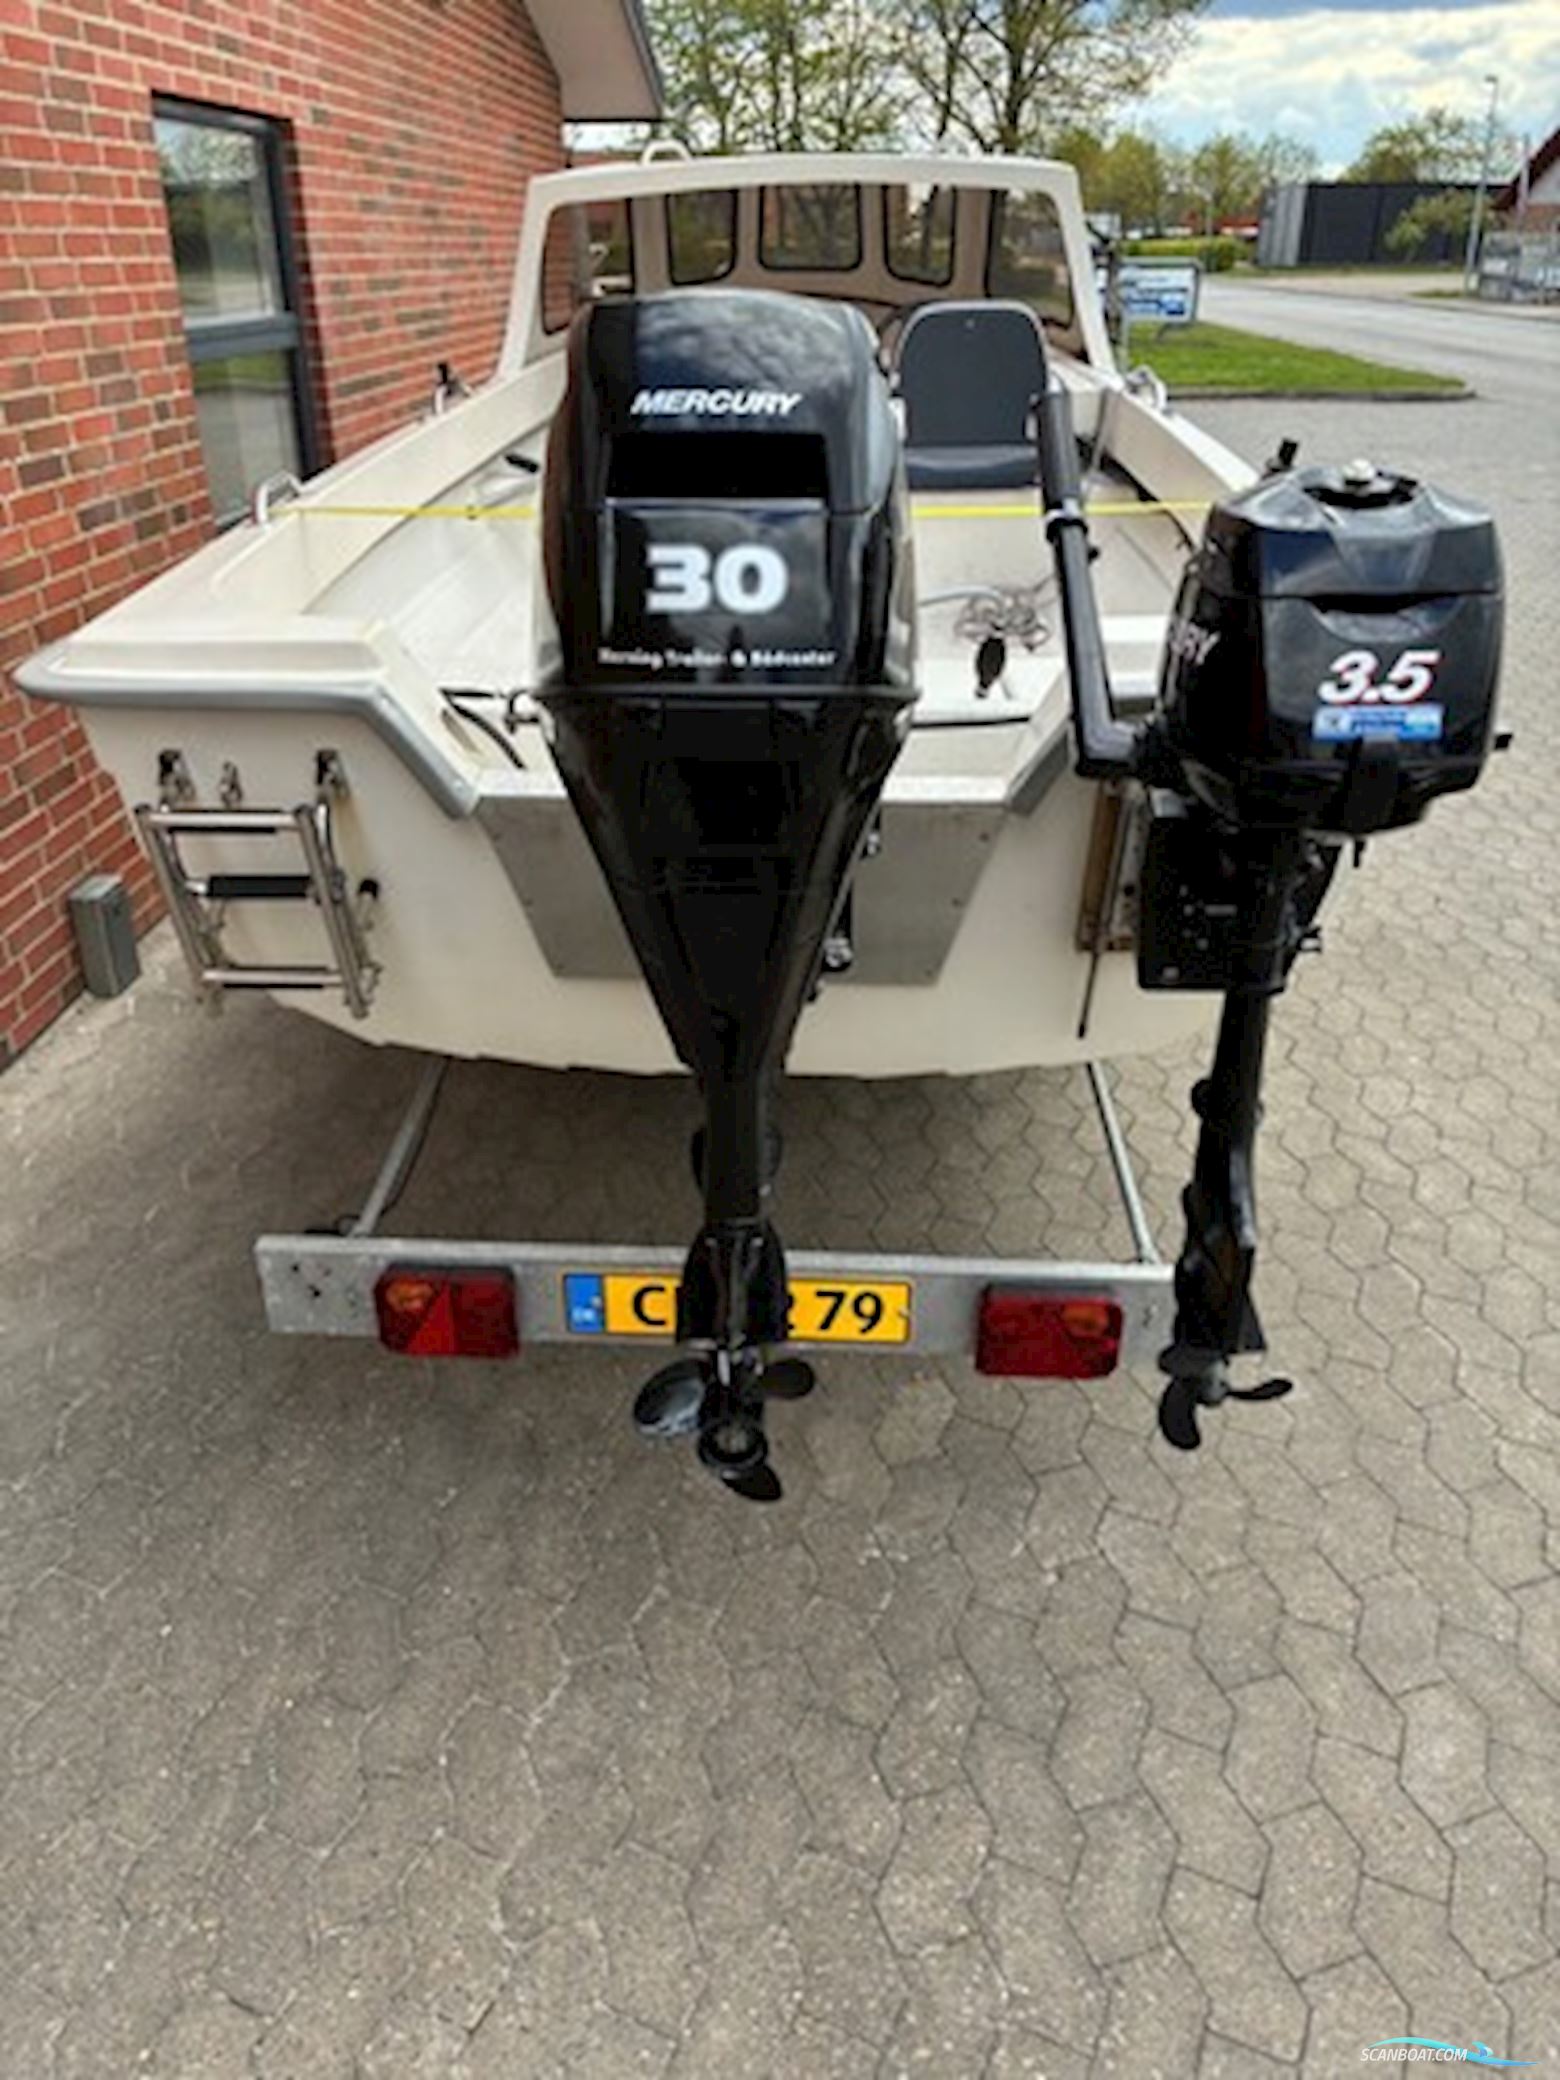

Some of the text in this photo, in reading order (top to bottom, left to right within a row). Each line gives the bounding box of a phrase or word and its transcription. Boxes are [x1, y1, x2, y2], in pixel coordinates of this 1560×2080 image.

[630, 389, 801, 415] MERCURY
[645, 543, 788, 616] 30
[1317, 650, 1441, 705] 3.5
[815, 1290, 883, 1334] 79
